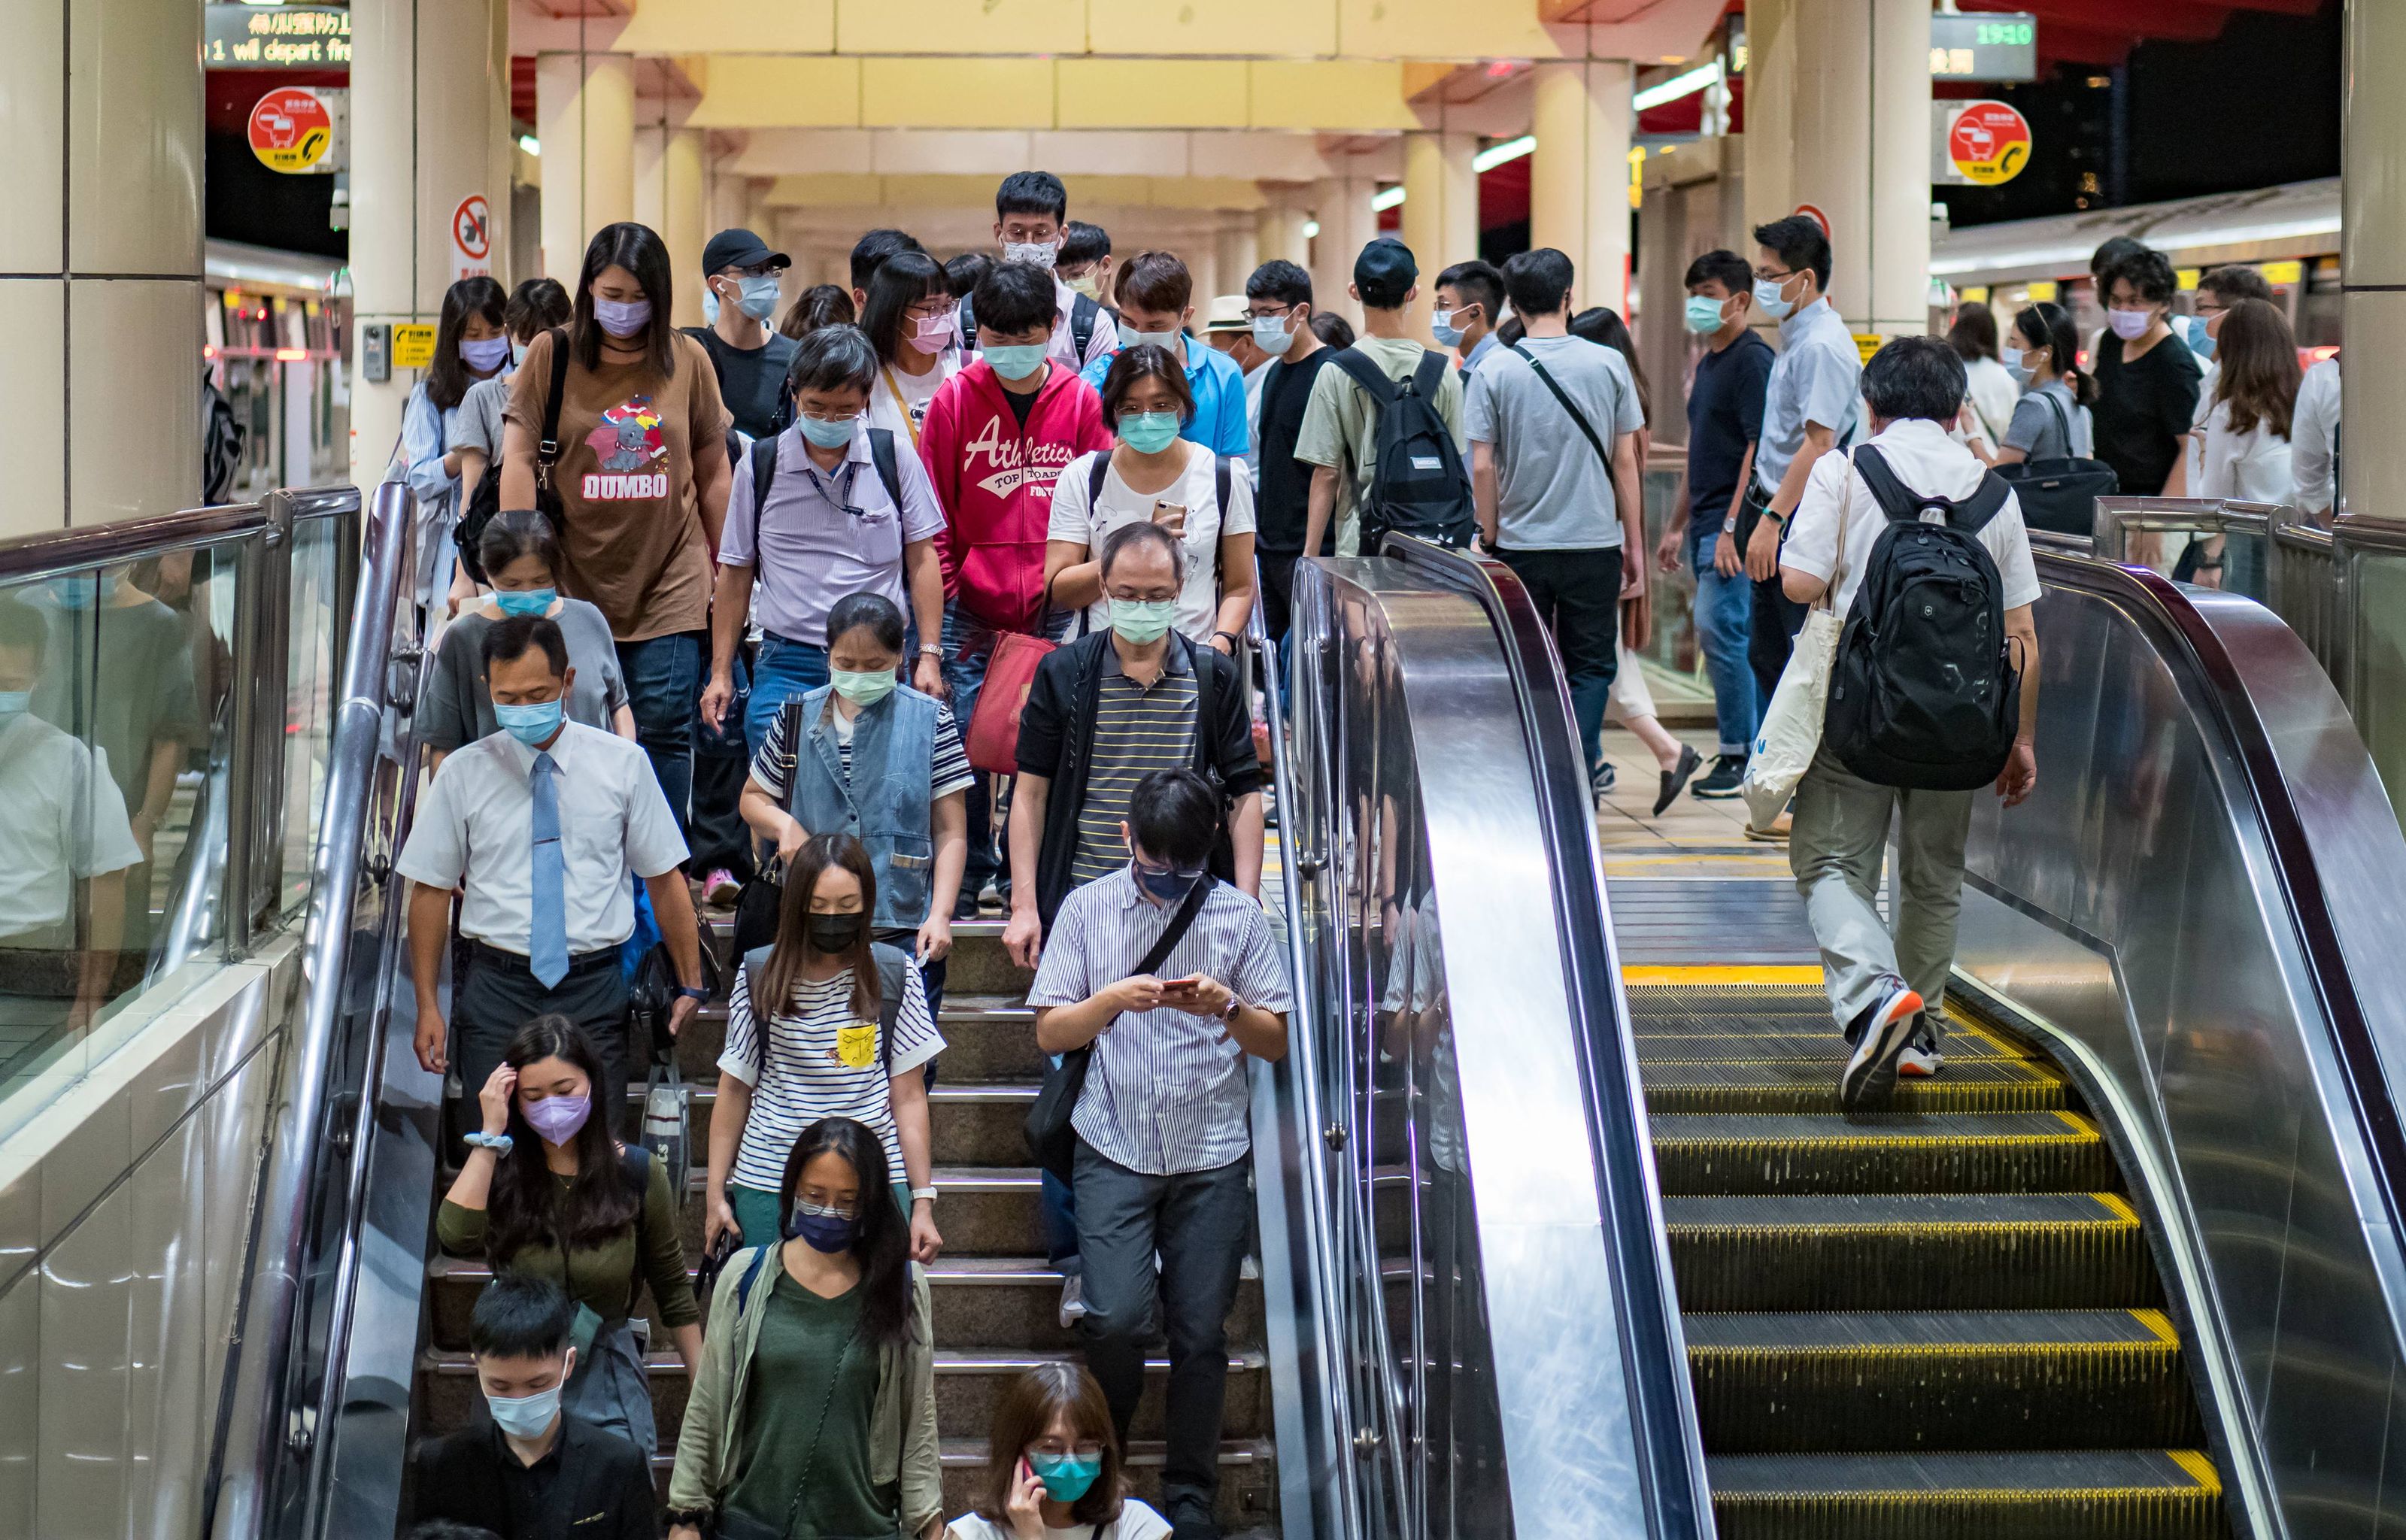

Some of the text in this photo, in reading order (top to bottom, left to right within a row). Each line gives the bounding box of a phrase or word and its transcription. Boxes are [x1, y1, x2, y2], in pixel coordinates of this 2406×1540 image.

[233, 38, 260, 61] will
[264, 38, 321, 66] depart
[963, 414, 1076, 472] Athletics
[583, 474, 667, 499] DUMBO
[994, 474, 1020, 489] TOP
